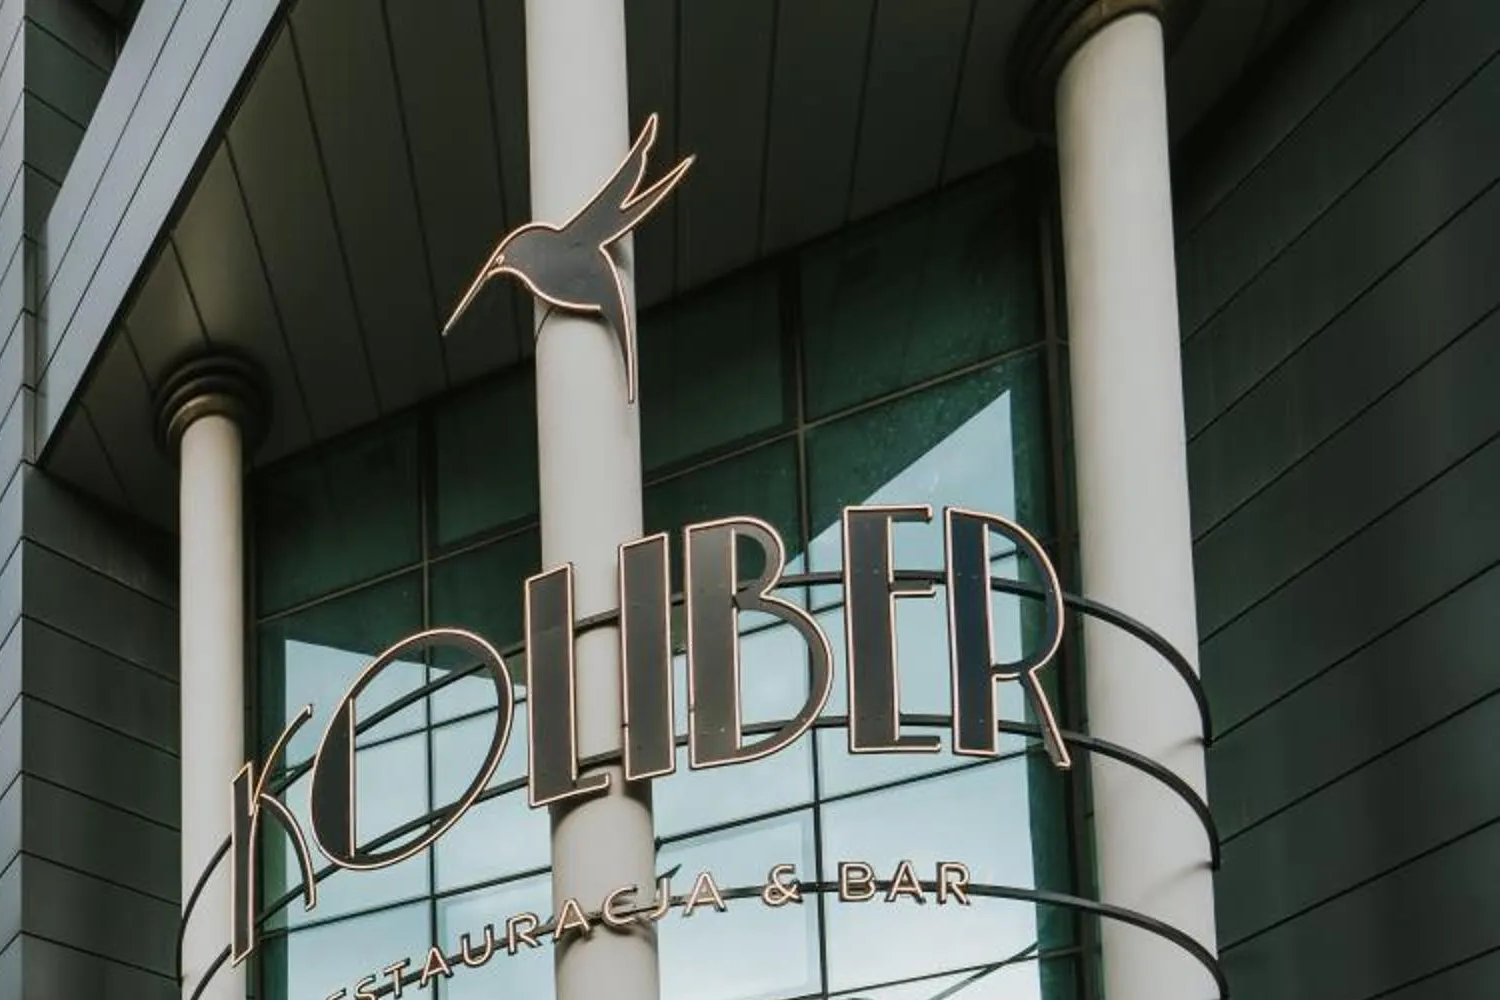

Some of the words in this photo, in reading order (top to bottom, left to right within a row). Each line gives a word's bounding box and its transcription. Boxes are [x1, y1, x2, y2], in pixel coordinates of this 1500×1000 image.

[231, 504, 1071, 967] KOLIBER
[762, 863, 803, 907] &
[837, 860, 972, 906] BAR
